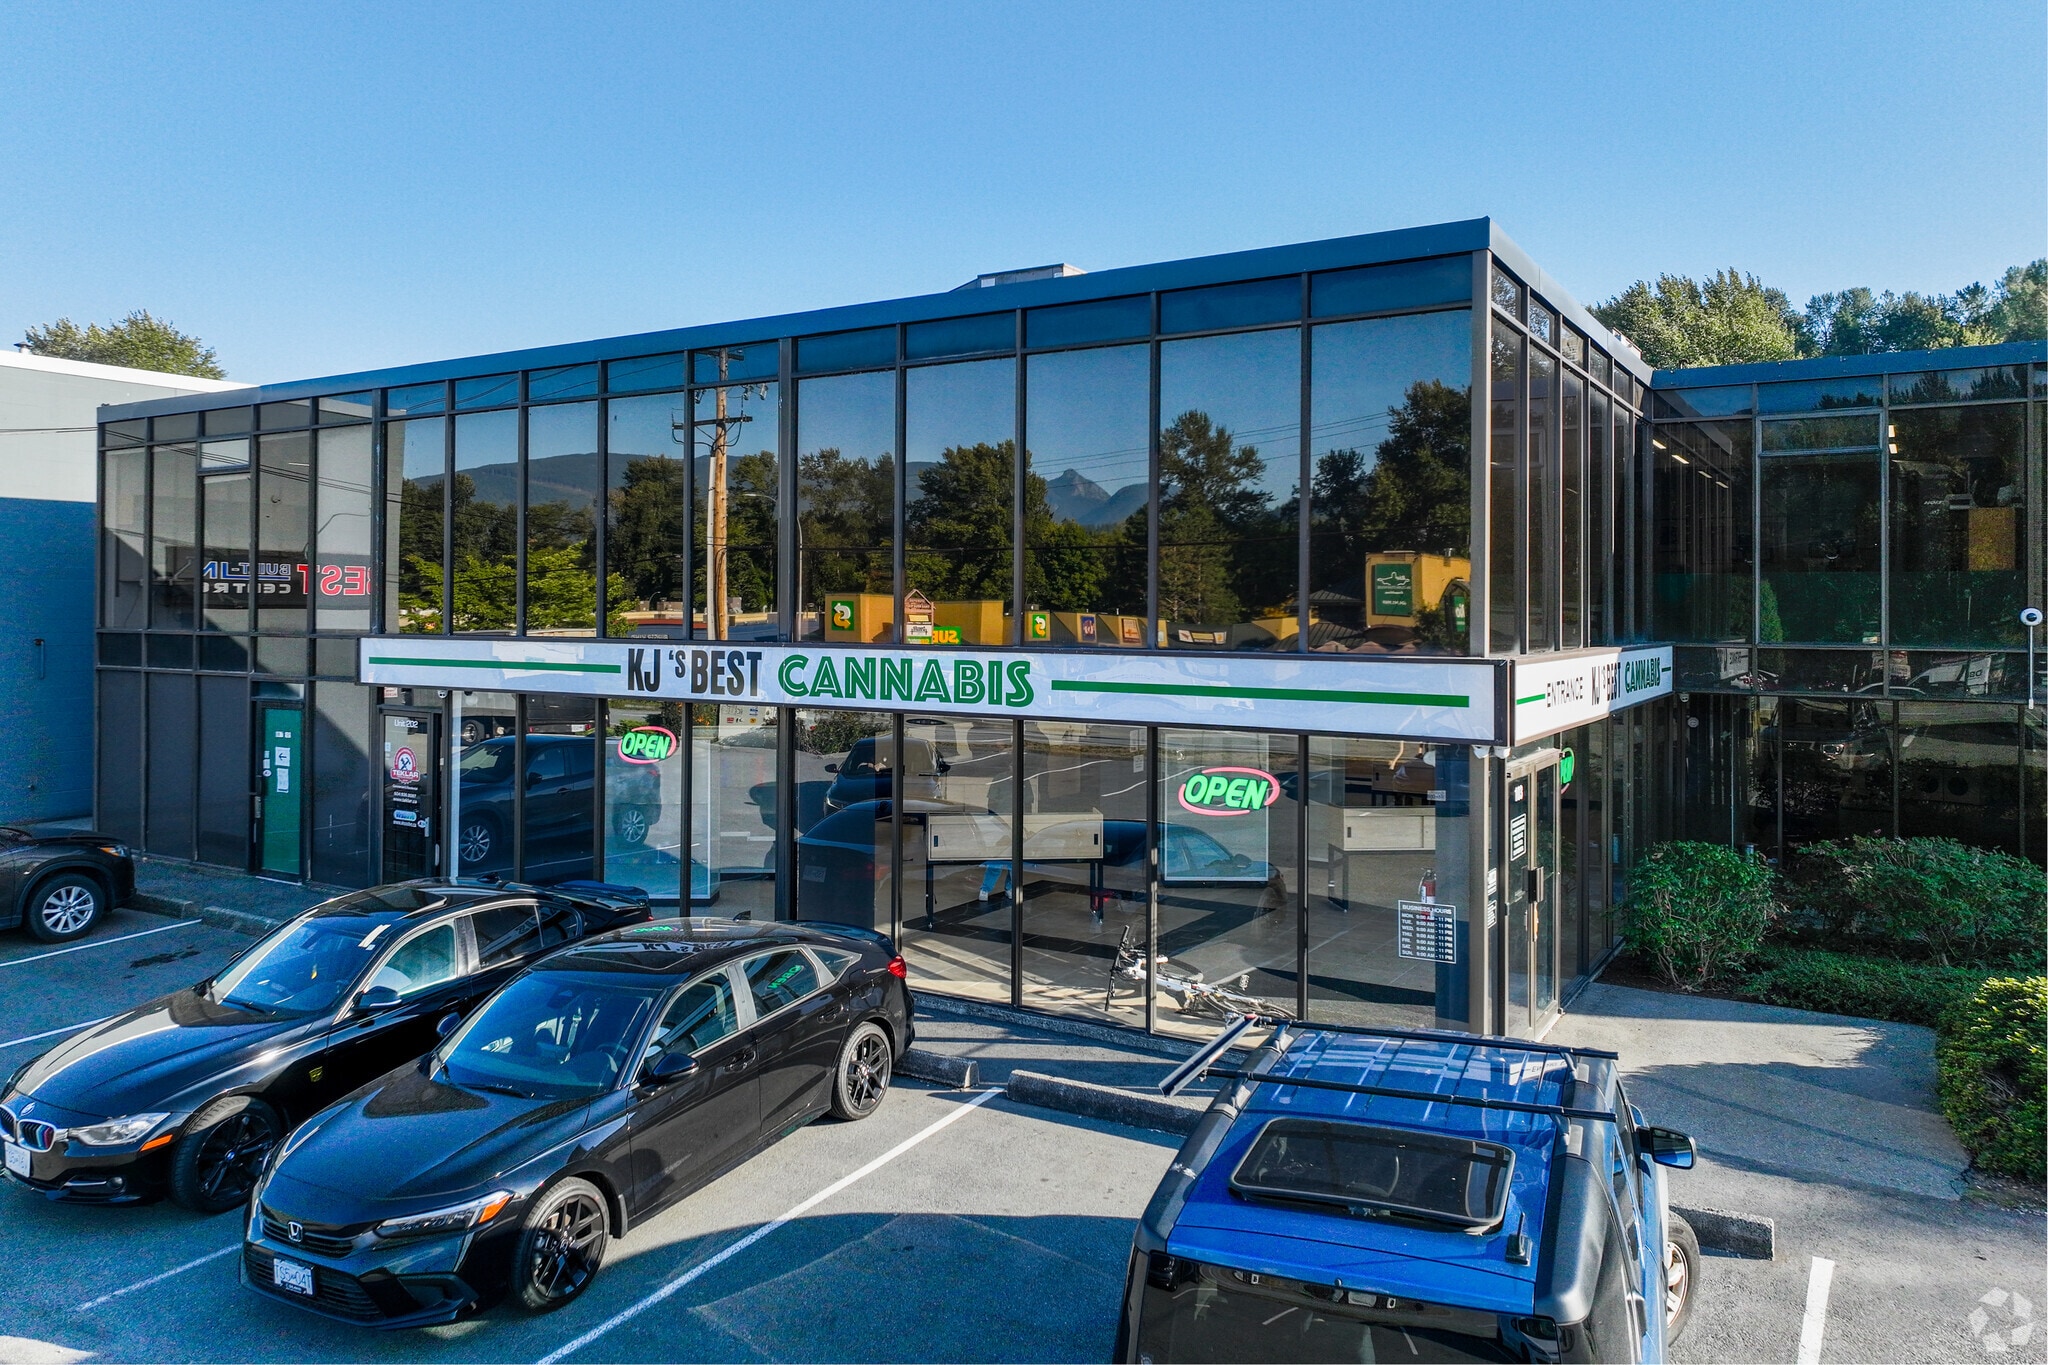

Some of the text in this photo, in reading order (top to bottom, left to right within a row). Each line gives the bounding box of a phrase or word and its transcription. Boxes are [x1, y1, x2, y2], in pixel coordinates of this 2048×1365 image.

[691, 650, 763, 697] BEST
[778, 654, 1035, 708] CANNABIS
[1546, 676, 1583, 708] ENTRANCE
[1606, 662, 1621, 701] BEST
[1624, 656, 1661, 693] CANNABIS
[621, 732, 670, 760] OPEN
[1184, 774, 1269, 810] OPEN
